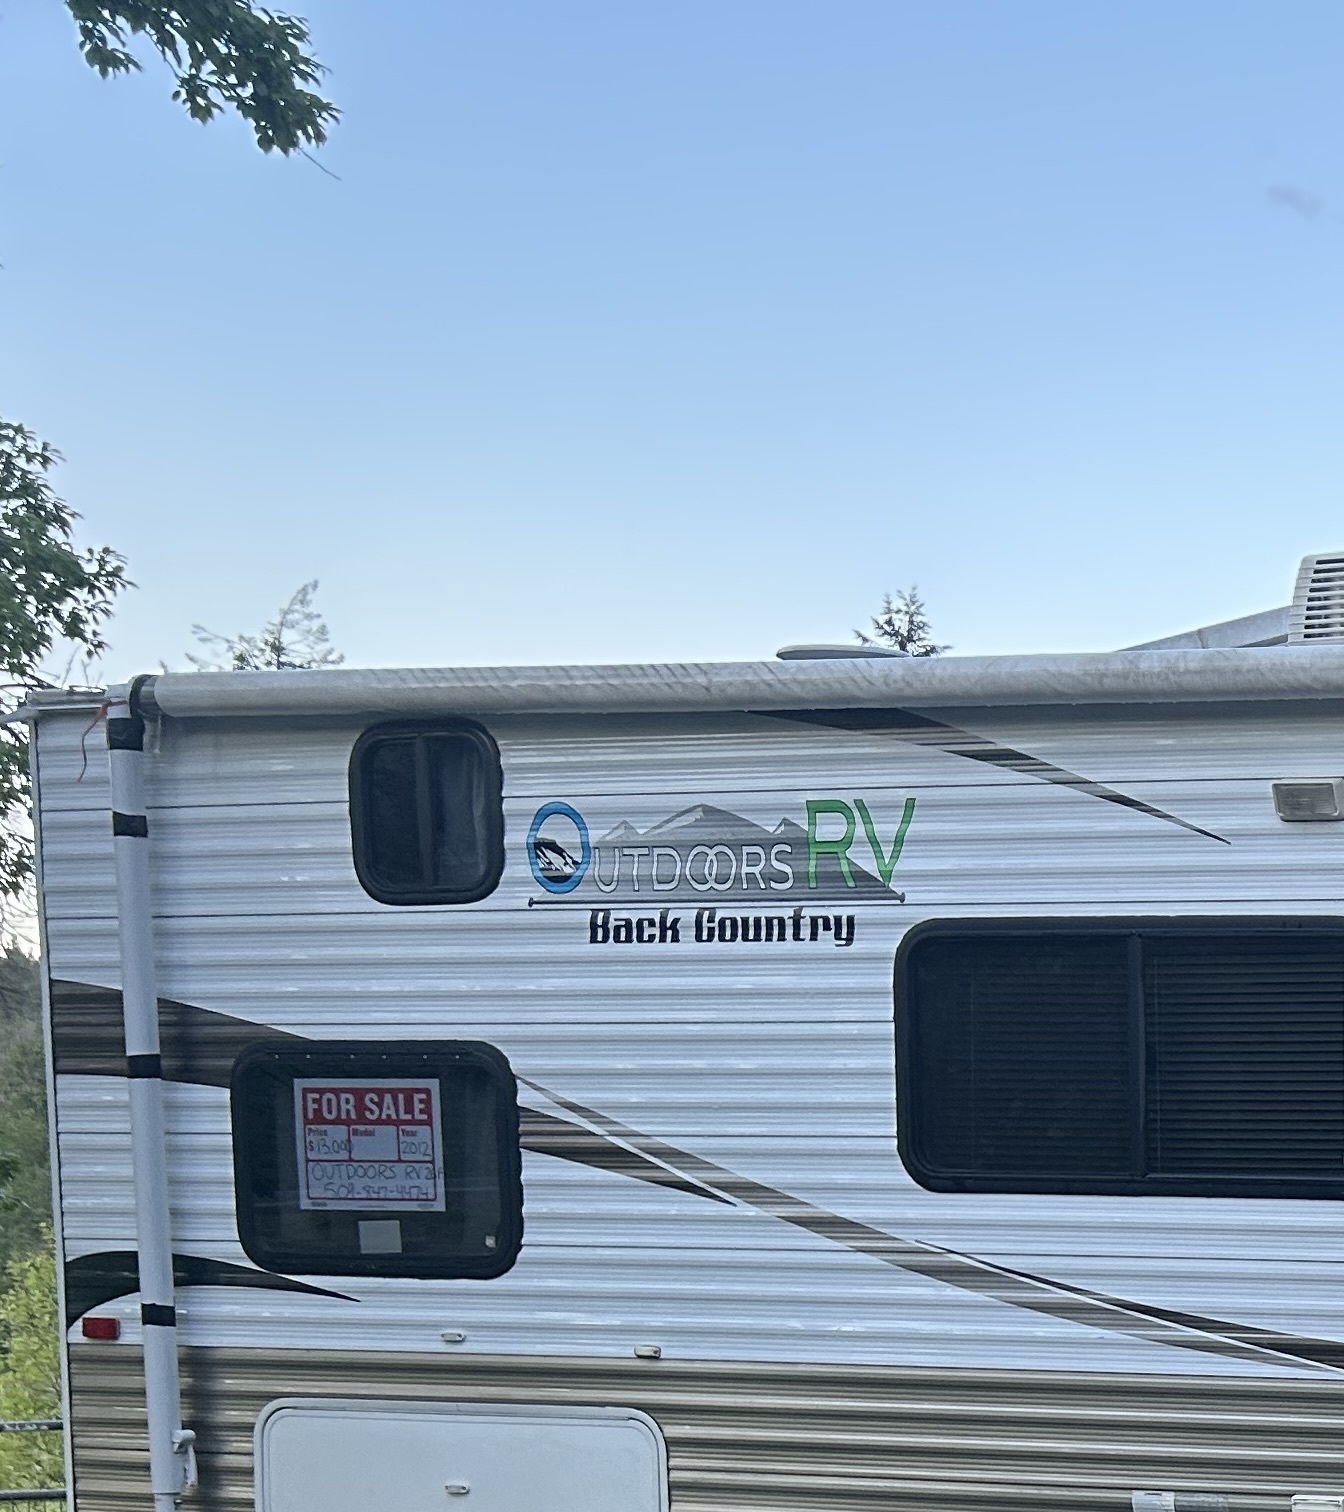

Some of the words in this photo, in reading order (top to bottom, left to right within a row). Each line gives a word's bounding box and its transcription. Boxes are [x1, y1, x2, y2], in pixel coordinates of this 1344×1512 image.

[527, 801, 794, 894] OUTDOORS
[806, 798, 916, 890] RV
[589, 908, 681, 945] Back
[695, 907, 856, 947] Country
[306, 1093, 356, 1120] FOR
[364, 1093, 428, 1120] SALE
[307, 1127, 328, 1137] Price
[352, 1127, 376, 1137] Model
[401, 1128, 418, 1137] Year
[401, 1140, 432, 1156] 2012
[311, 1163, 397, 1180] OUTDOORS
[404, 1164, 421, 1180] RV
